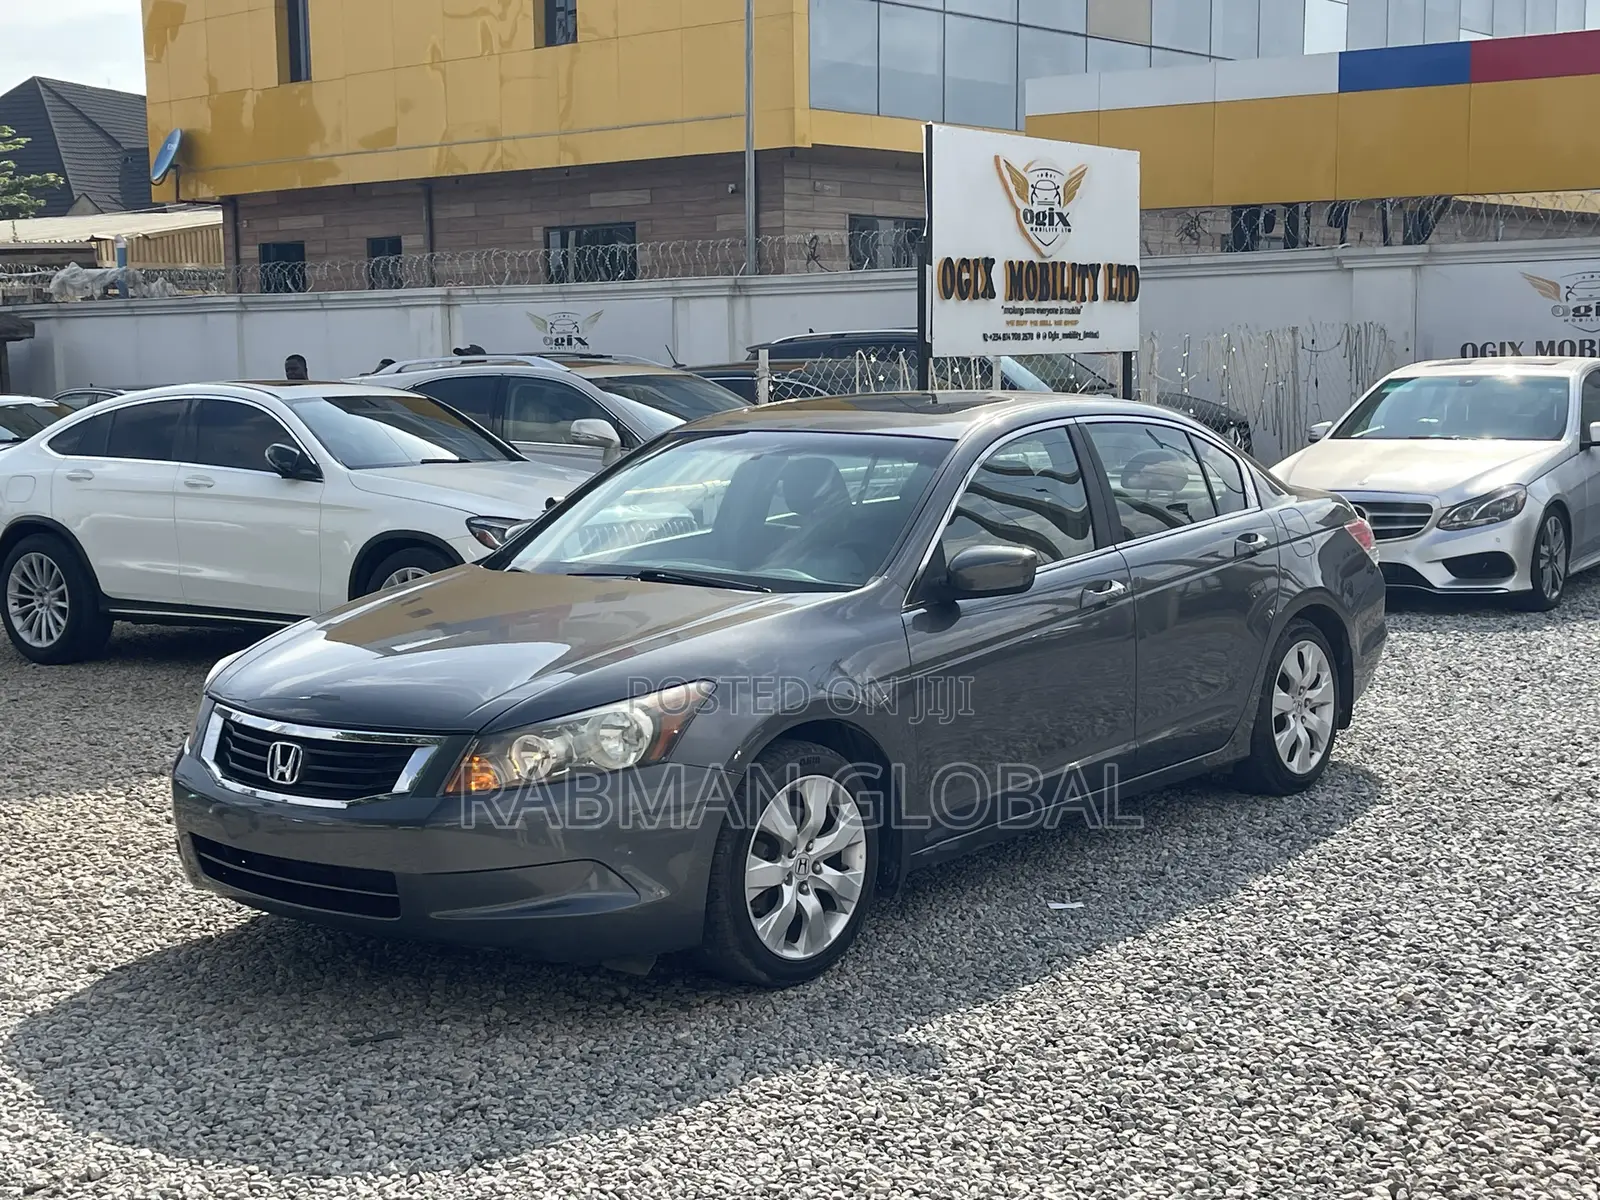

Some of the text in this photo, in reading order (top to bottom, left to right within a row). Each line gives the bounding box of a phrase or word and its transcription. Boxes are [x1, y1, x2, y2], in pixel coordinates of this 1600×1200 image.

[937, 257, 1140, 303] OGIX MOBILITY LTD
[1460, 339, 1600, 358] OGIX MOB
